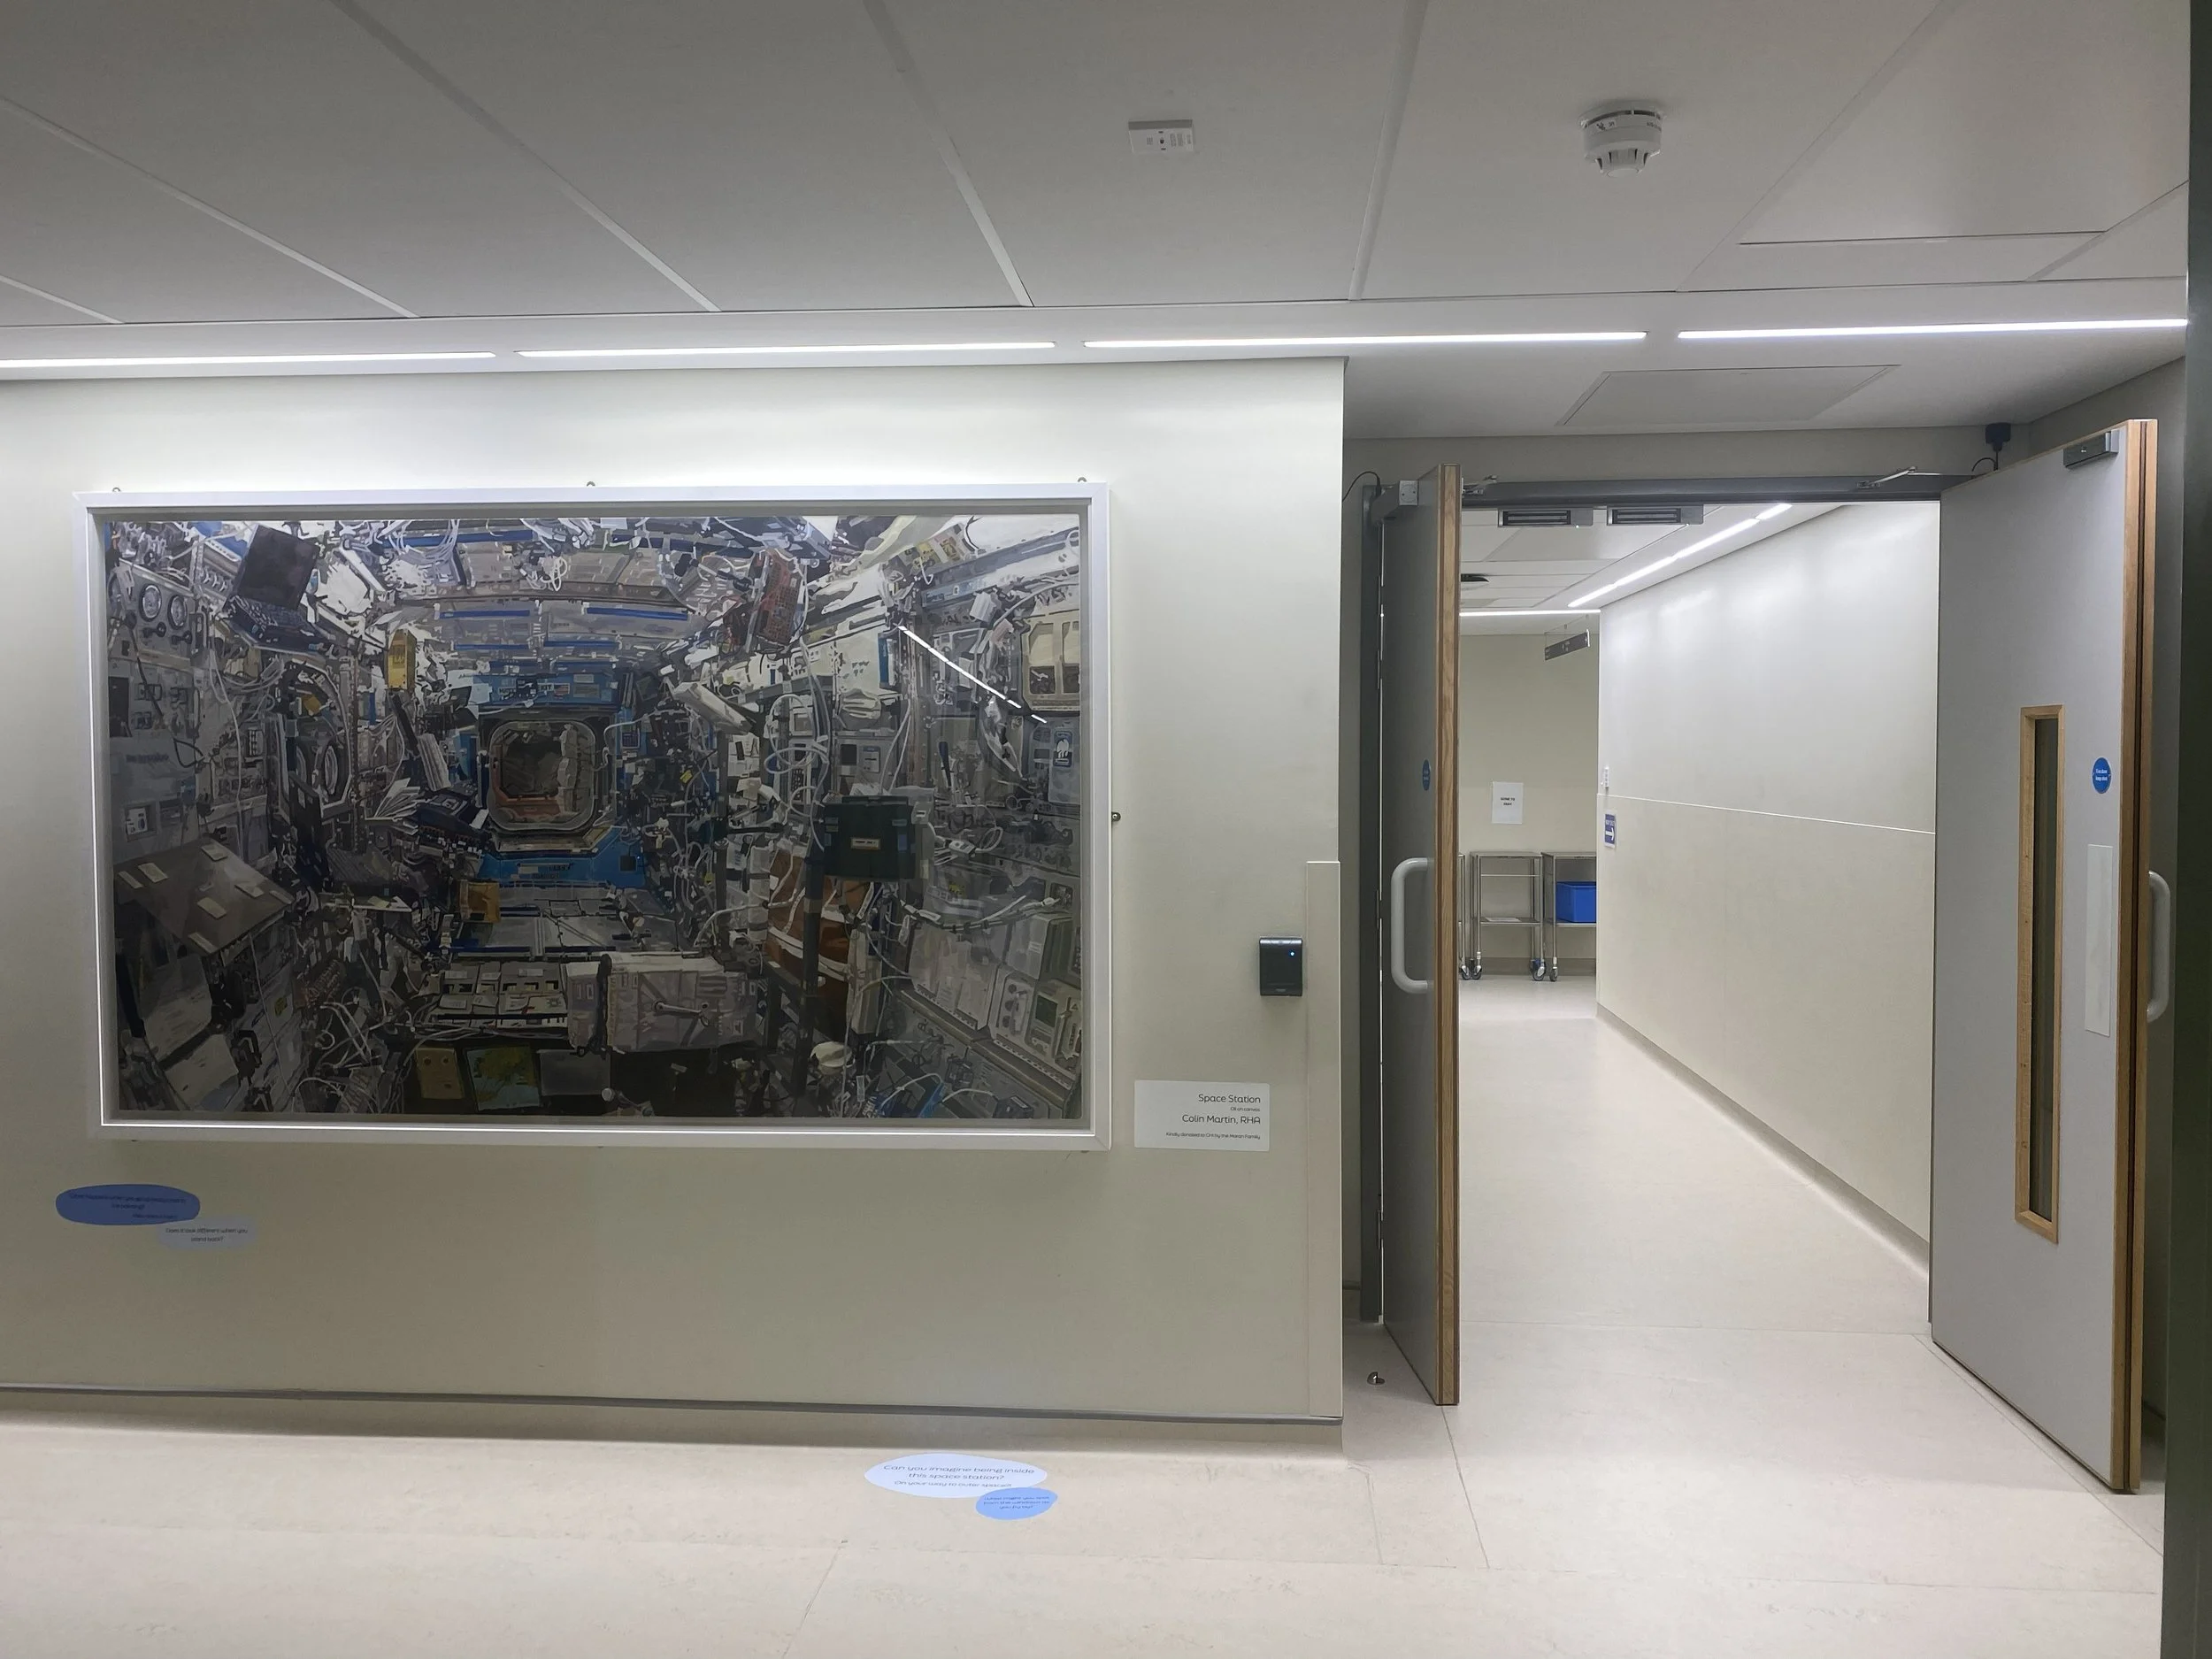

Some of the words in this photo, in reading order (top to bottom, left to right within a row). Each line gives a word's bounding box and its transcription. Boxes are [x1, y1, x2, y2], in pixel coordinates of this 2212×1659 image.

[1198, 1094, 1226, 1103] Space
[1228, 1094, 1261, 1103] Station
[1182, 1114, 1204, 1123] Colin
[1207, 1115, 1238, 1125] Martin,
